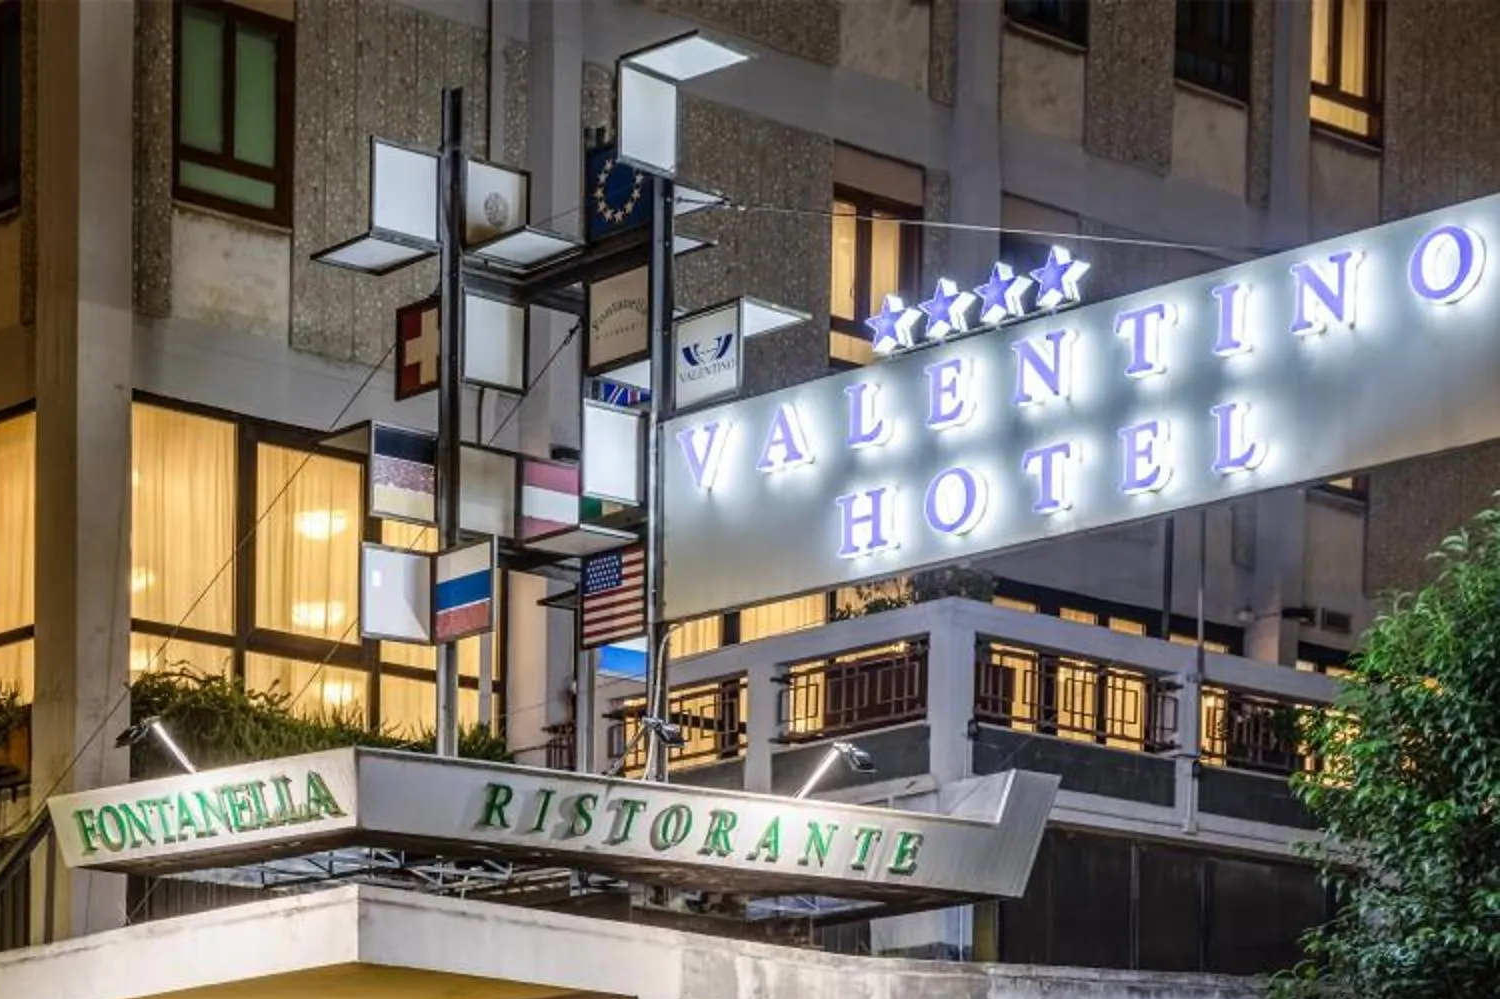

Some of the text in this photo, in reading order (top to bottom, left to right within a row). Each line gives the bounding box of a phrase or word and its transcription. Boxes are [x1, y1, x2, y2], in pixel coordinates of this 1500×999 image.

[676, 225, 1485, 489] VALENTINO
[678, 358, 735, 384] VALENTINO
[836, 402, 1266, 559] HOTEL
[73, 769, 348, 855] FONTANELLA
[475, 782, 924, 876] RISTORANTE
